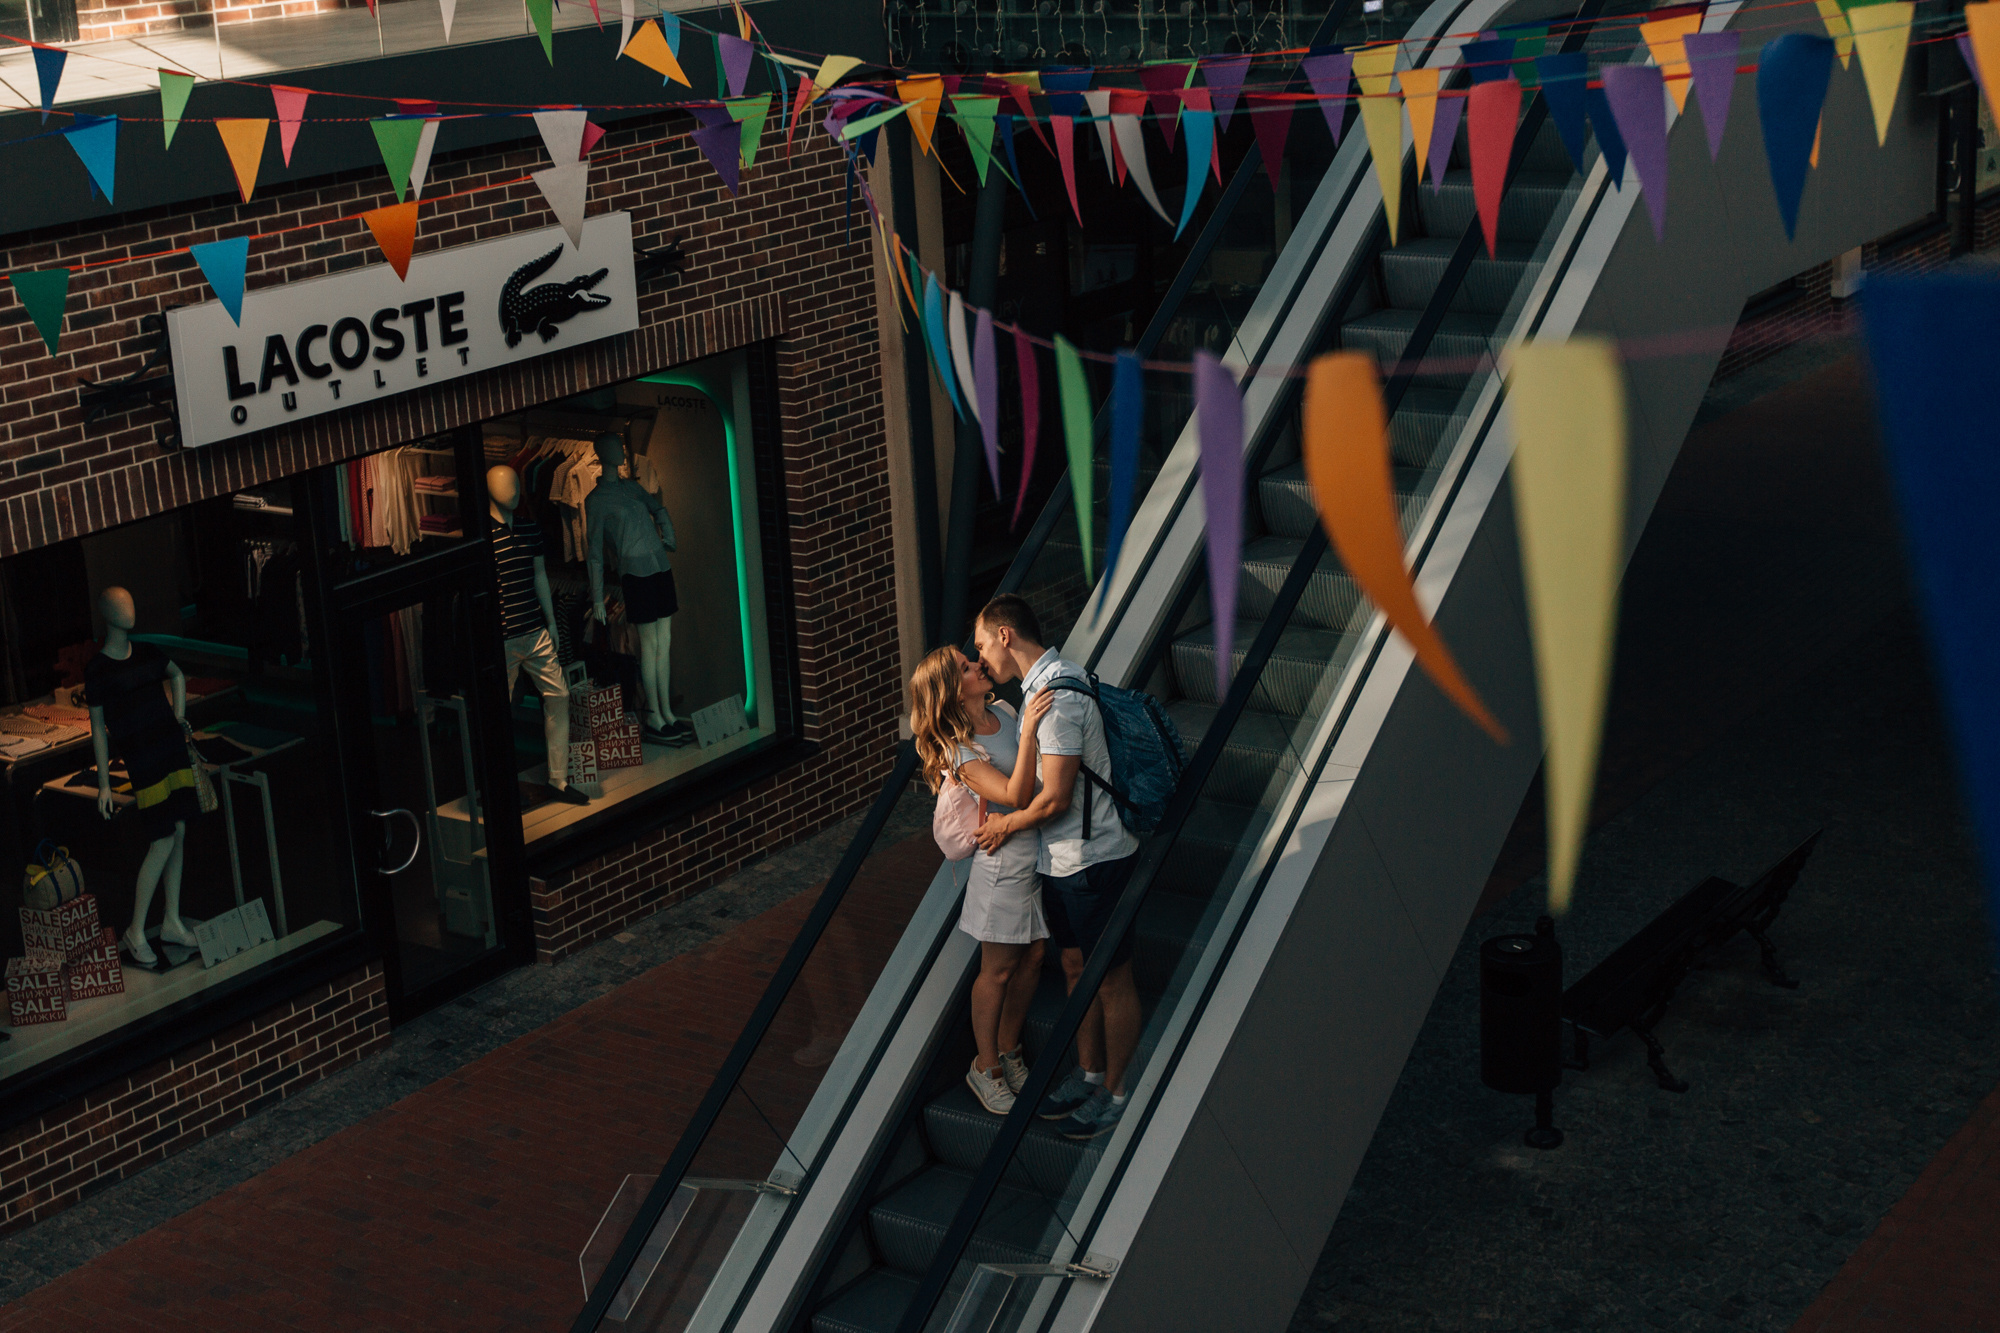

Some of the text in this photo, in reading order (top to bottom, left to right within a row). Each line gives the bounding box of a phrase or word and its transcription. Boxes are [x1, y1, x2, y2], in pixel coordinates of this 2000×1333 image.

[222, 291, 469, 401] LACOSTE
[230, 346, 470, 426] OUTLET
[657, 395, 707, 409] LACOSTE
[569, 692, 588, 708] ALE
[589, 686, 622, 708] SALE
[591, 699, 622, 715] ЗНИЖКИ
[570, 713, 590, 729] ALE
[592, 707, 623, 728] SALE
[593, 720, 624, 737] ЗНИЖКИ
[599, 737, 640, 749] ЗНИЖКИ
[600, 745, 641, 761] SALE
[581, 743, 597, 783] SALE
[601, 757, 642, 769] ЗНИЖКИ
[21, 909, 60, 928] SALE
[61, 897, 98, 927] SALE
[23, 924, 61, 936] ЗНИЖКИ
[63, 912, 99, 936] ЗНИЖКИ
[25, 933, 64, 952] SALE
[65, 921, 101, 951] SALE
[69, 960, 119, 976] ЗНИЖКИ
[7, 972, 60, 992] SALE
[70, 969, 122, 991] SALE
[9, 987, 62, 1002] ЗНИЖКИ
[72, 983, 123, 1000] ЗНИЖКИ
[11, 996, 64, 1016] SALE
[12, 1011, 66, 1025] ЗНИЖКИ
